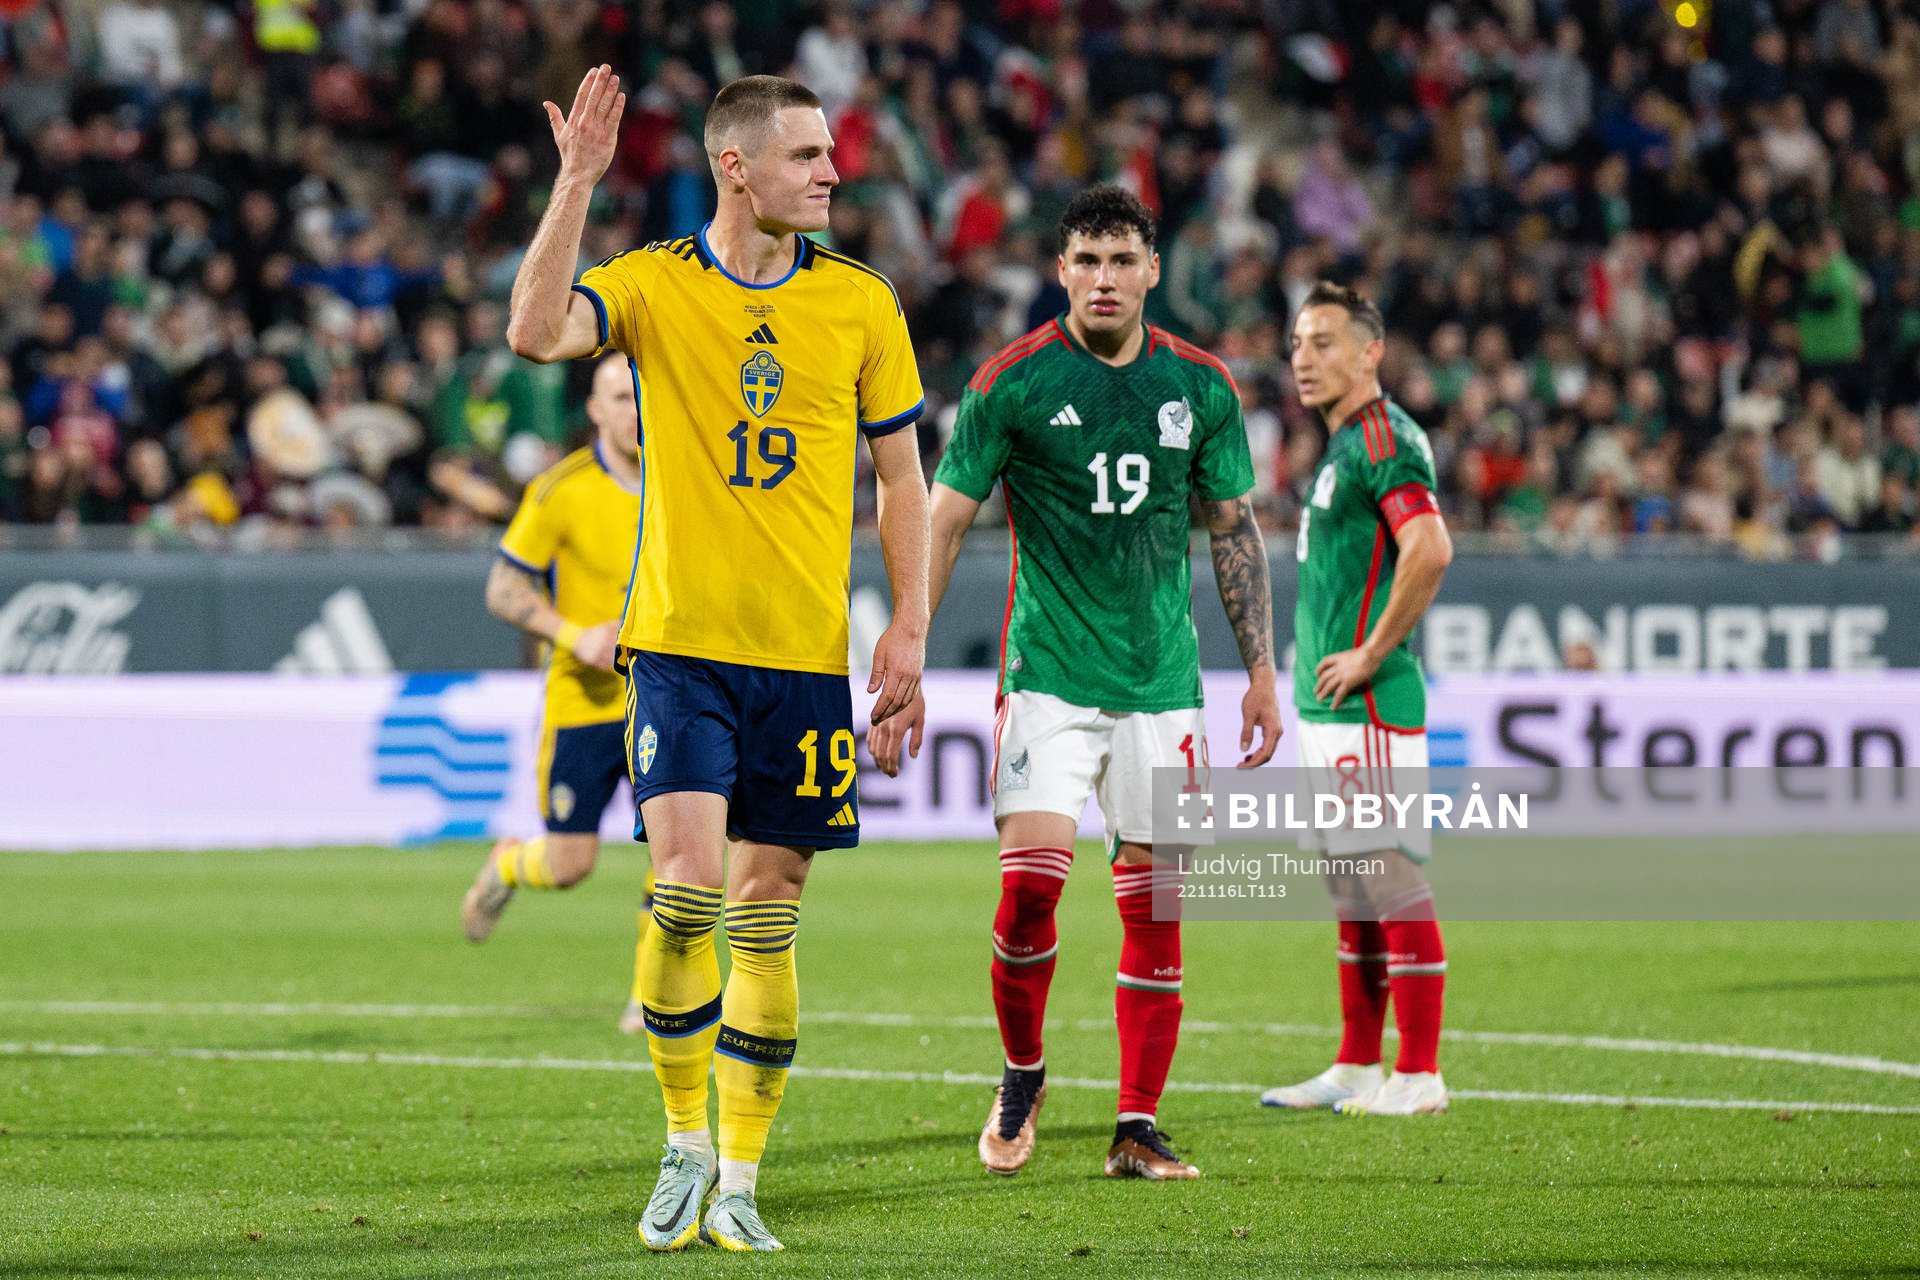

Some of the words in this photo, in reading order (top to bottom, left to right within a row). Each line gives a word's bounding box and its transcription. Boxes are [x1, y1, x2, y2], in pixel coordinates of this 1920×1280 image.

[749, 369, 776, 377] SVERIGE
[727, 420, 797, 490] 19
[1087, 452, 1150, 515] 19
[1424, 603, 1888, 671] BANORTE
[796, 729, 857, 798] 19
[1497, 700, 1907, 802] Steren
